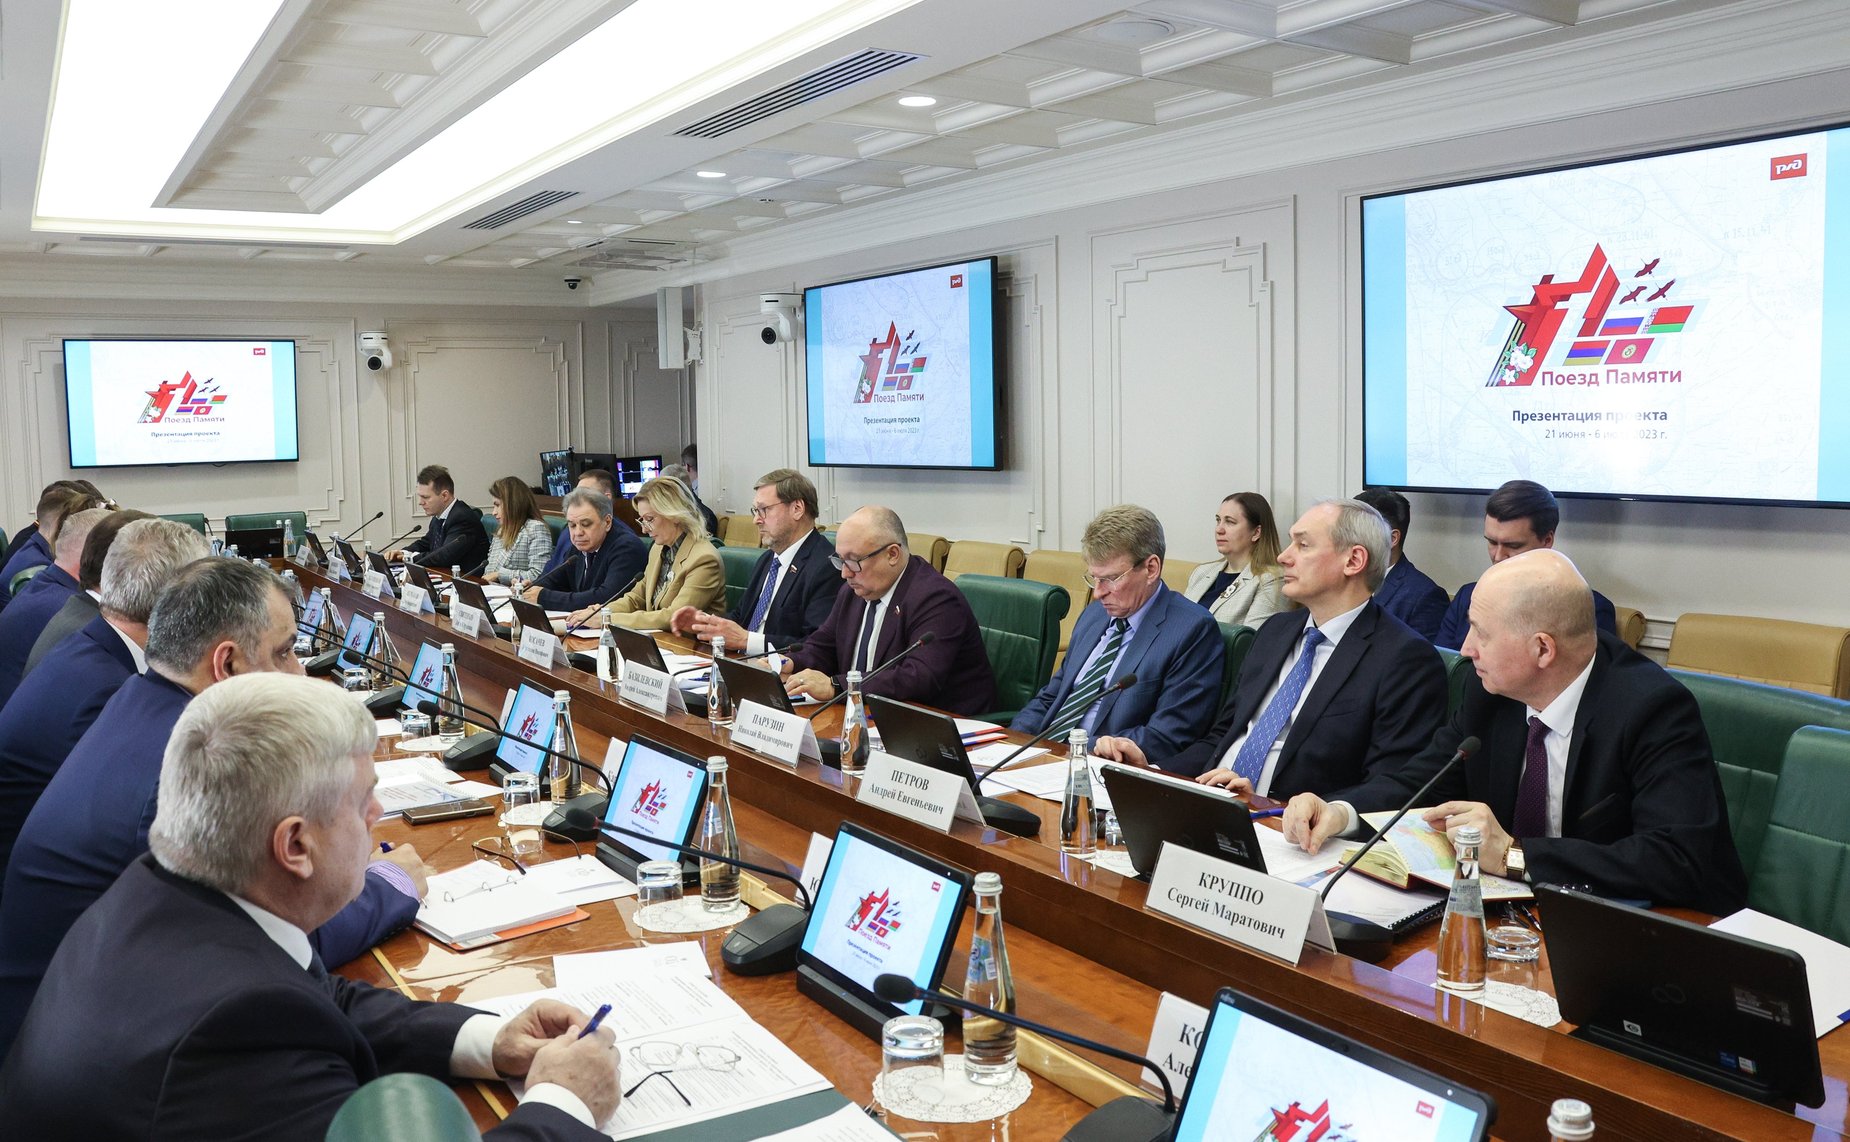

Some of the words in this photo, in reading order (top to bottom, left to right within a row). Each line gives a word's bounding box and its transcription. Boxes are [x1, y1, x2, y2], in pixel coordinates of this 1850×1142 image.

[1541, 371, 1600, 387] Поезд
[1606, 369, 1682, 385] Памяти
[874, 394, 896, 404] Поезд
[897, 392, 925, 402] Памяти
[164, 416, 192, 424] Поезд
[864, 416, 897, 425] Презентация
[898, 416, 921, 425] проекта
[1512, 410, 1602, 424] Презентация
[1545, 429, 1556, 439] 21
[1558, 431, 1586, 439] июня
[1594, 429, 1600, 439] 6
[1660, 431, 1668, 439] г.
[752, 714, 785, 733] ПАРУЗИН
[757, 730, 794, 750] Владимирович
[890, 769, 930, 791] ПЕТРОВ
[869, 783, 897, 799] Андрей
[896, 790, 944, 815] Евгеньевич
[1198, 871, 1264, 906] КРУППО
[1167, 886, 1210, 913] Сергей
[1212, 901, 1286, 939] Маратович
[1178, 1021, 1205, 1050] КО
[1162, 1052, 1193, 1079] Але
